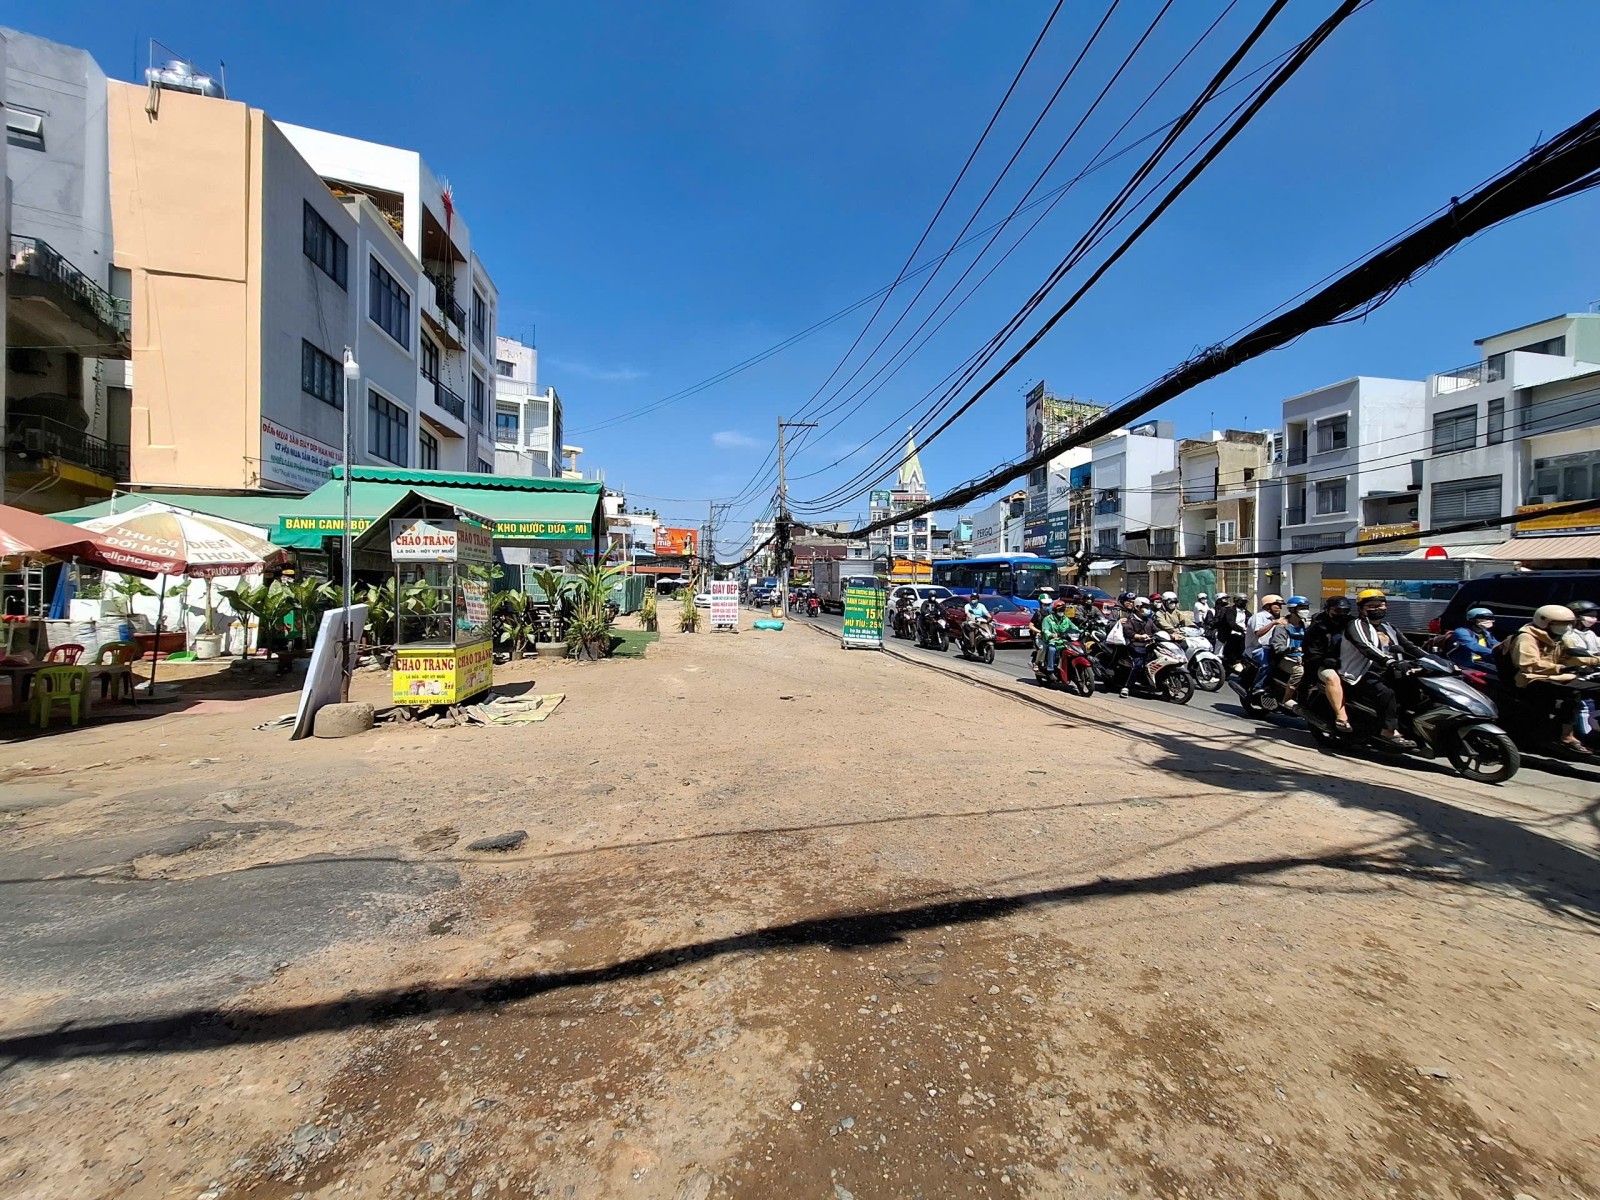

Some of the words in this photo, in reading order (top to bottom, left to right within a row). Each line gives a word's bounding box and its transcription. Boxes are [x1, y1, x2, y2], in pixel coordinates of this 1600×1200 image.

[286, 517, 316, 529] BÁNH
[498, 524, 516, 533] KHO
[520, 522, 545, 533] NƯỚC
[117, 528, 152, 540] THU
[977, 526, 992, 538] PERGO
